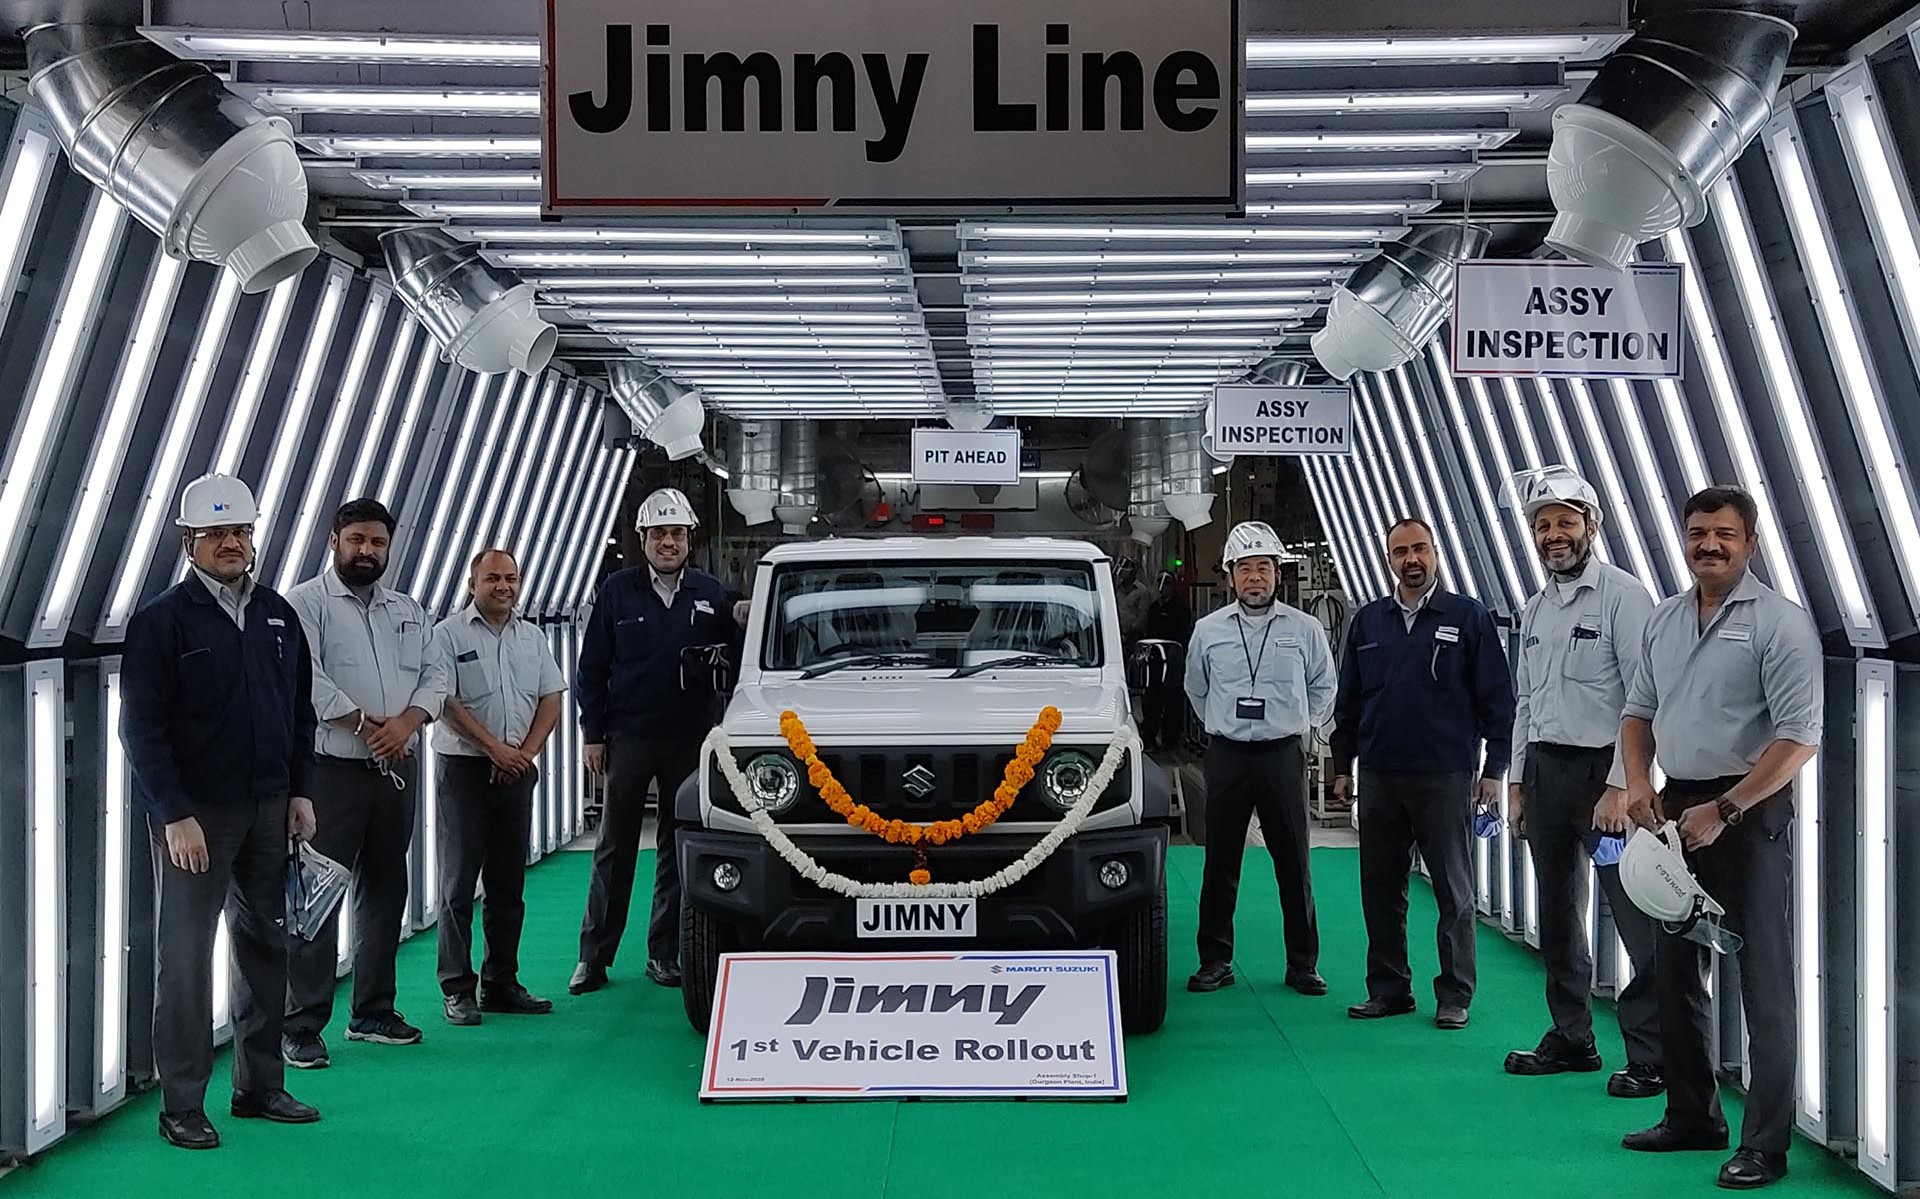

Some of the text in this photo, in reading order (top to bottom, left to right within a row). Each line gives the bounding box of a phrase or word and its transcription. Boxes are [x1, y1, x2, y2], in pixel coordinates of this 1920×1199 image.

[568, 24, 1221, 163] Jimny Line
[1525, 286, 1614, 316] ASSY
[1466, 329, 1669, 361] INSPECTION
[1256, 400, 1310, 418] ASSY
[1222, 426, 1344, 445] INSPECTION
[925, 450, 1007, 464] PIT AHEAD
[862, 903, 970, 932] JIMNY
[784, 976, 1046, 1025] Jimny
[730, 1038, 1096, 1062] 1st Vehicle Rollout
